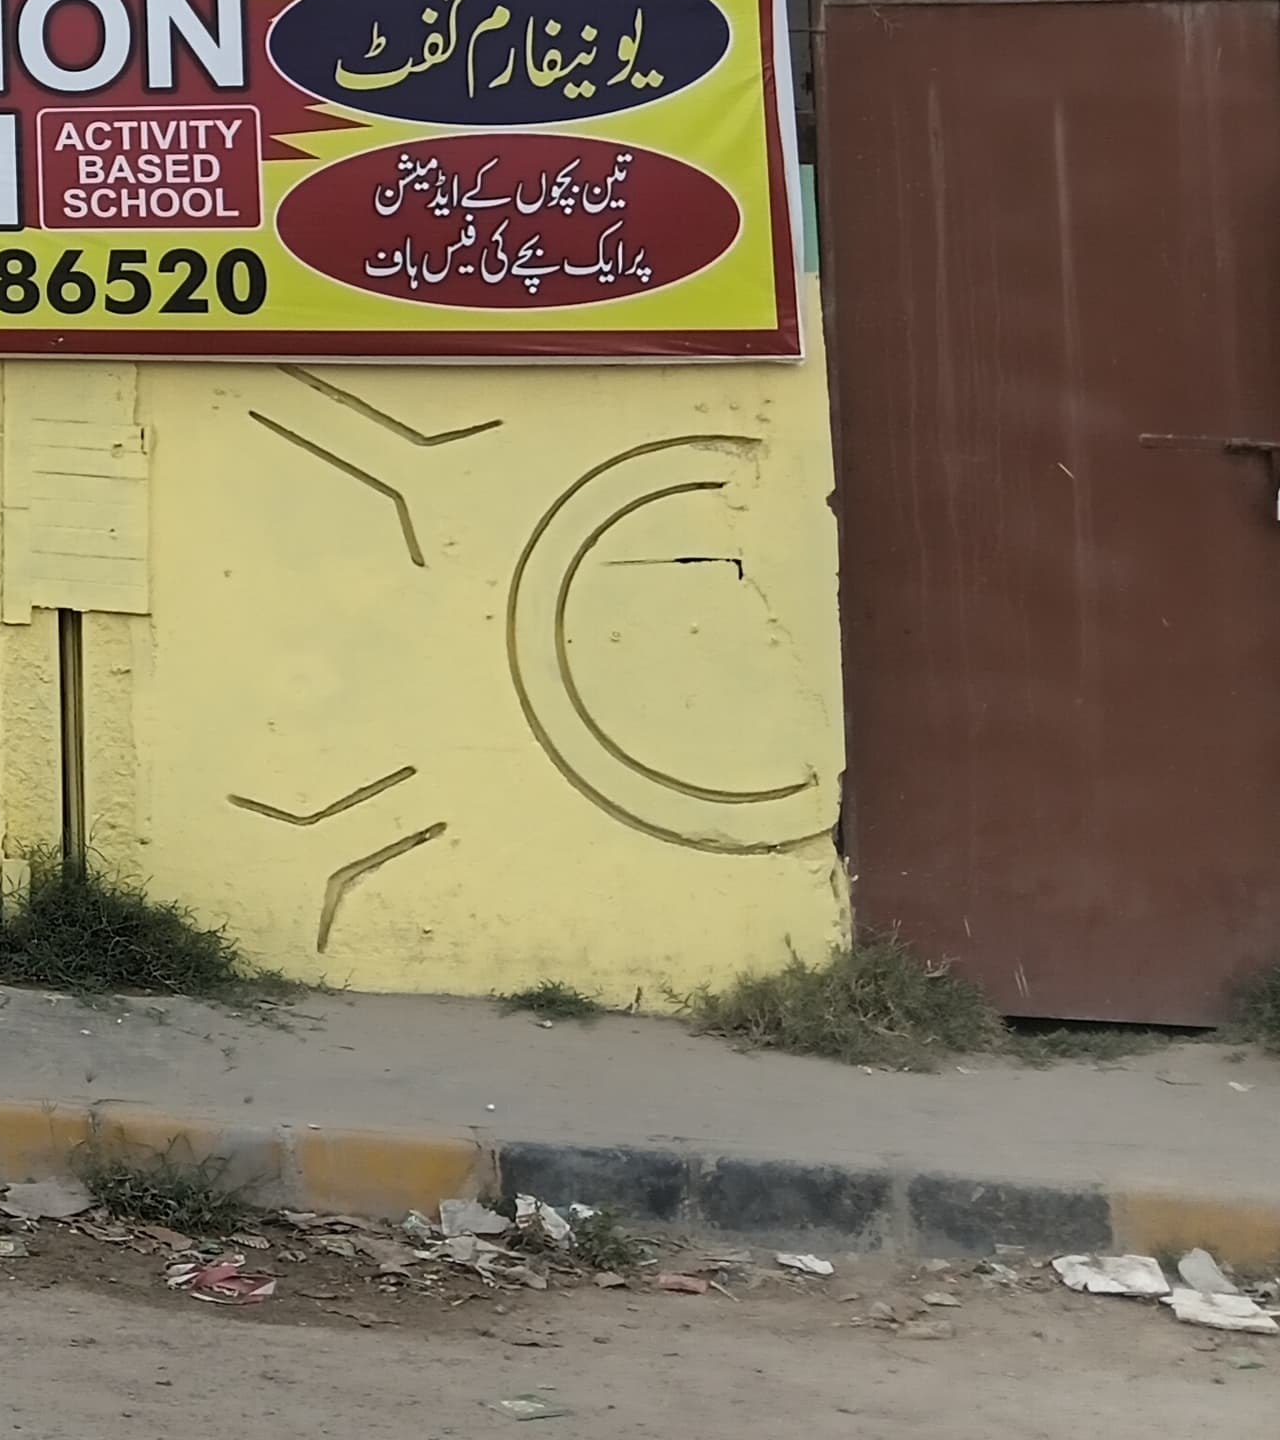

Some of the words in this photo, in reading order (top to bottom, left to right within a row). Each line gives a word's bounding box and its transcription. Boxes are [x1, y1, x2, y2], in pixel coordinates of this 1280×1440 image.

[54, 119, 243, 152] ACTIVITY
[78, 154, 222, 186] BASED
[62, 188, 239, 220] SCHOOL
